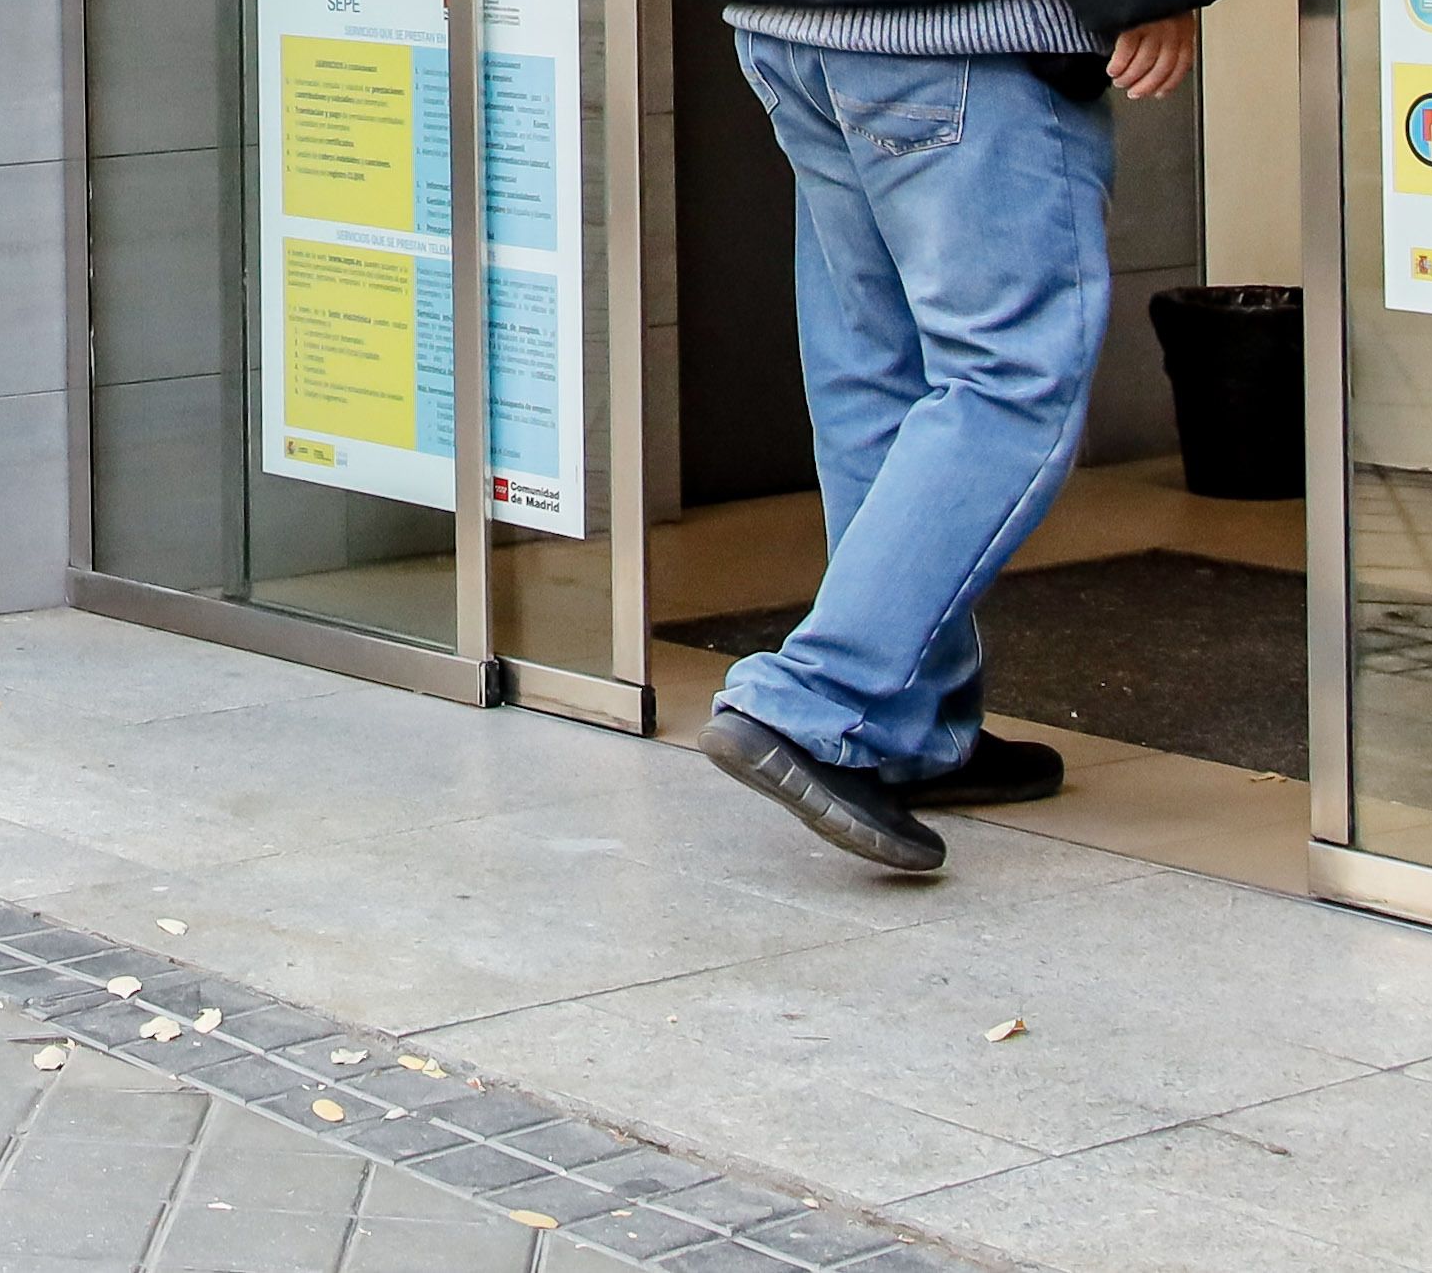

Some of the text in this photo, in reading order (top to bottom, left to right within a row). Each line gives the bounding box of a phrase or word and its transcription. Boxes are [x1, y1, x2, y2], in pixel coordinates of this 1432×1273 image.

[510, 481, 560, 500] Comunidad
[510, 494, 560, 513] de Madrid
